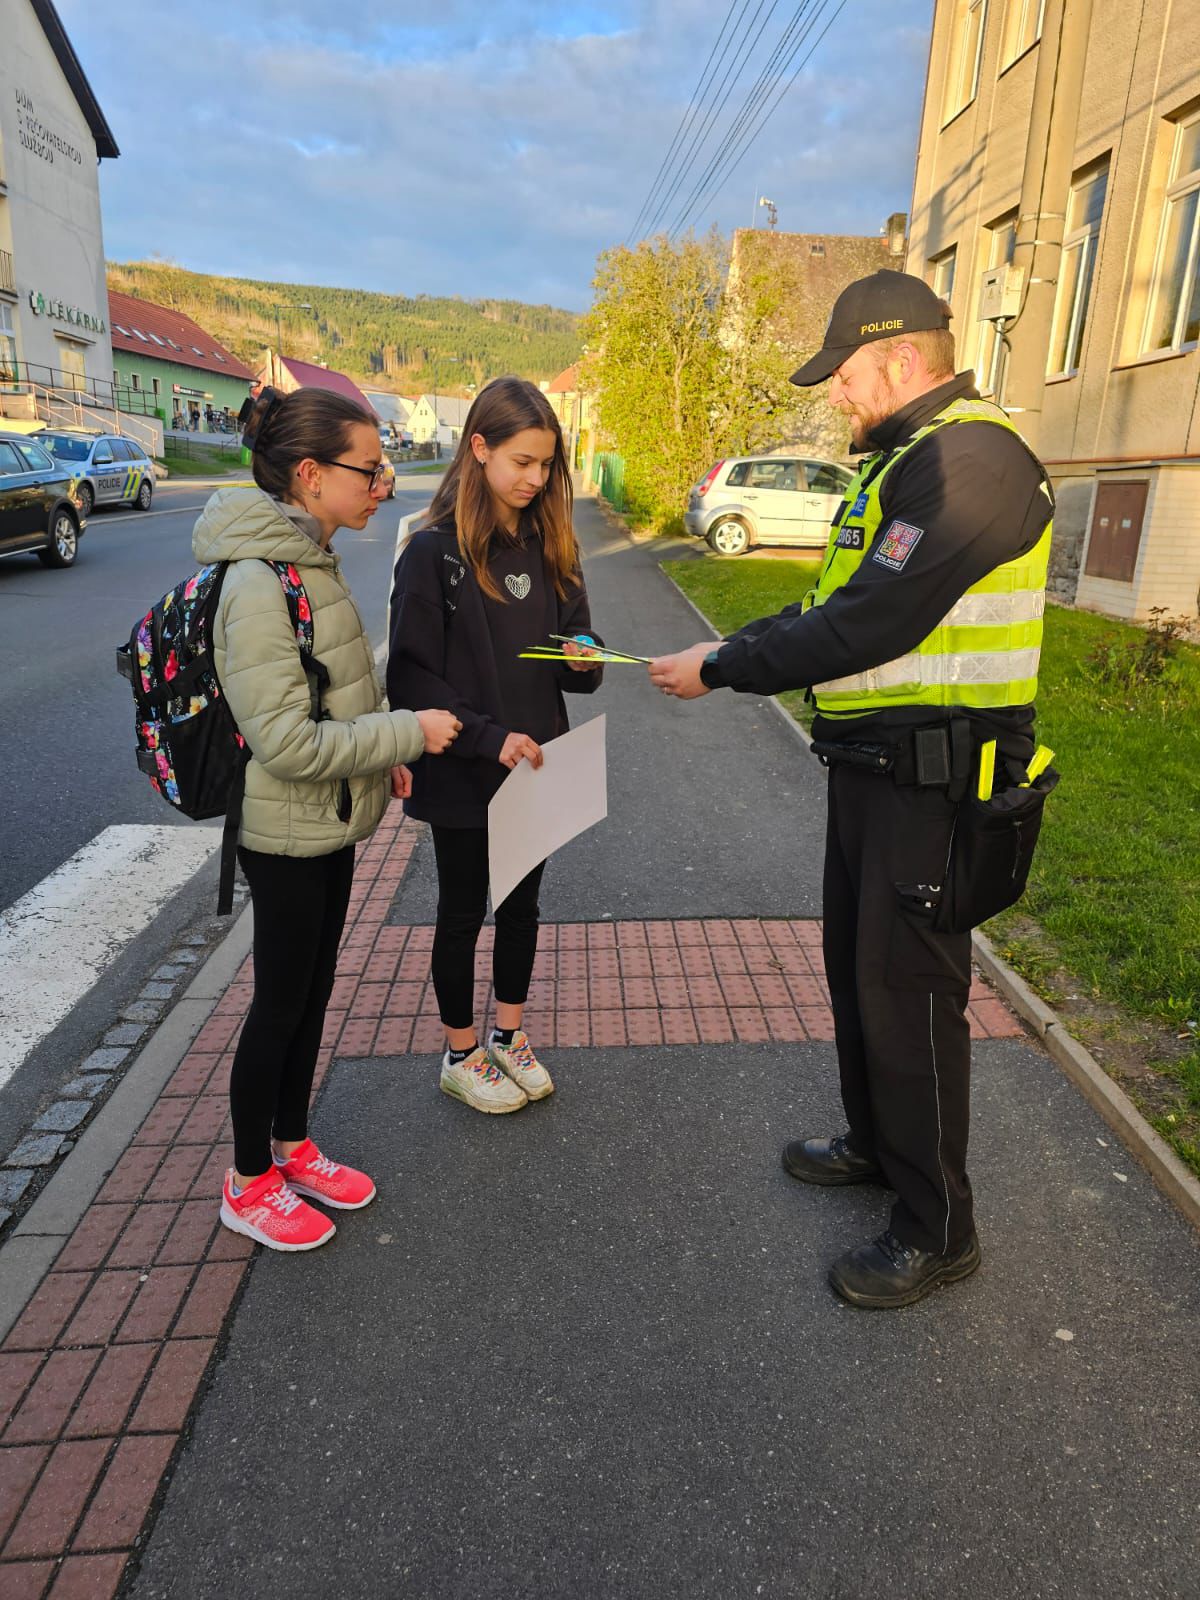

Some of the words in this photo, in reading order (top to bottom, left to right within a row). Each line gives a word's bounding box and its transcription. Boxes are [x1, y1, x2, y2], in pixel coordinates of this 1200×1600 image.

[860, 319, 904, 336] POLICIE
[98, 478, 120, 488] POLICIE
[875, 553, 902, 567] POLICIE
